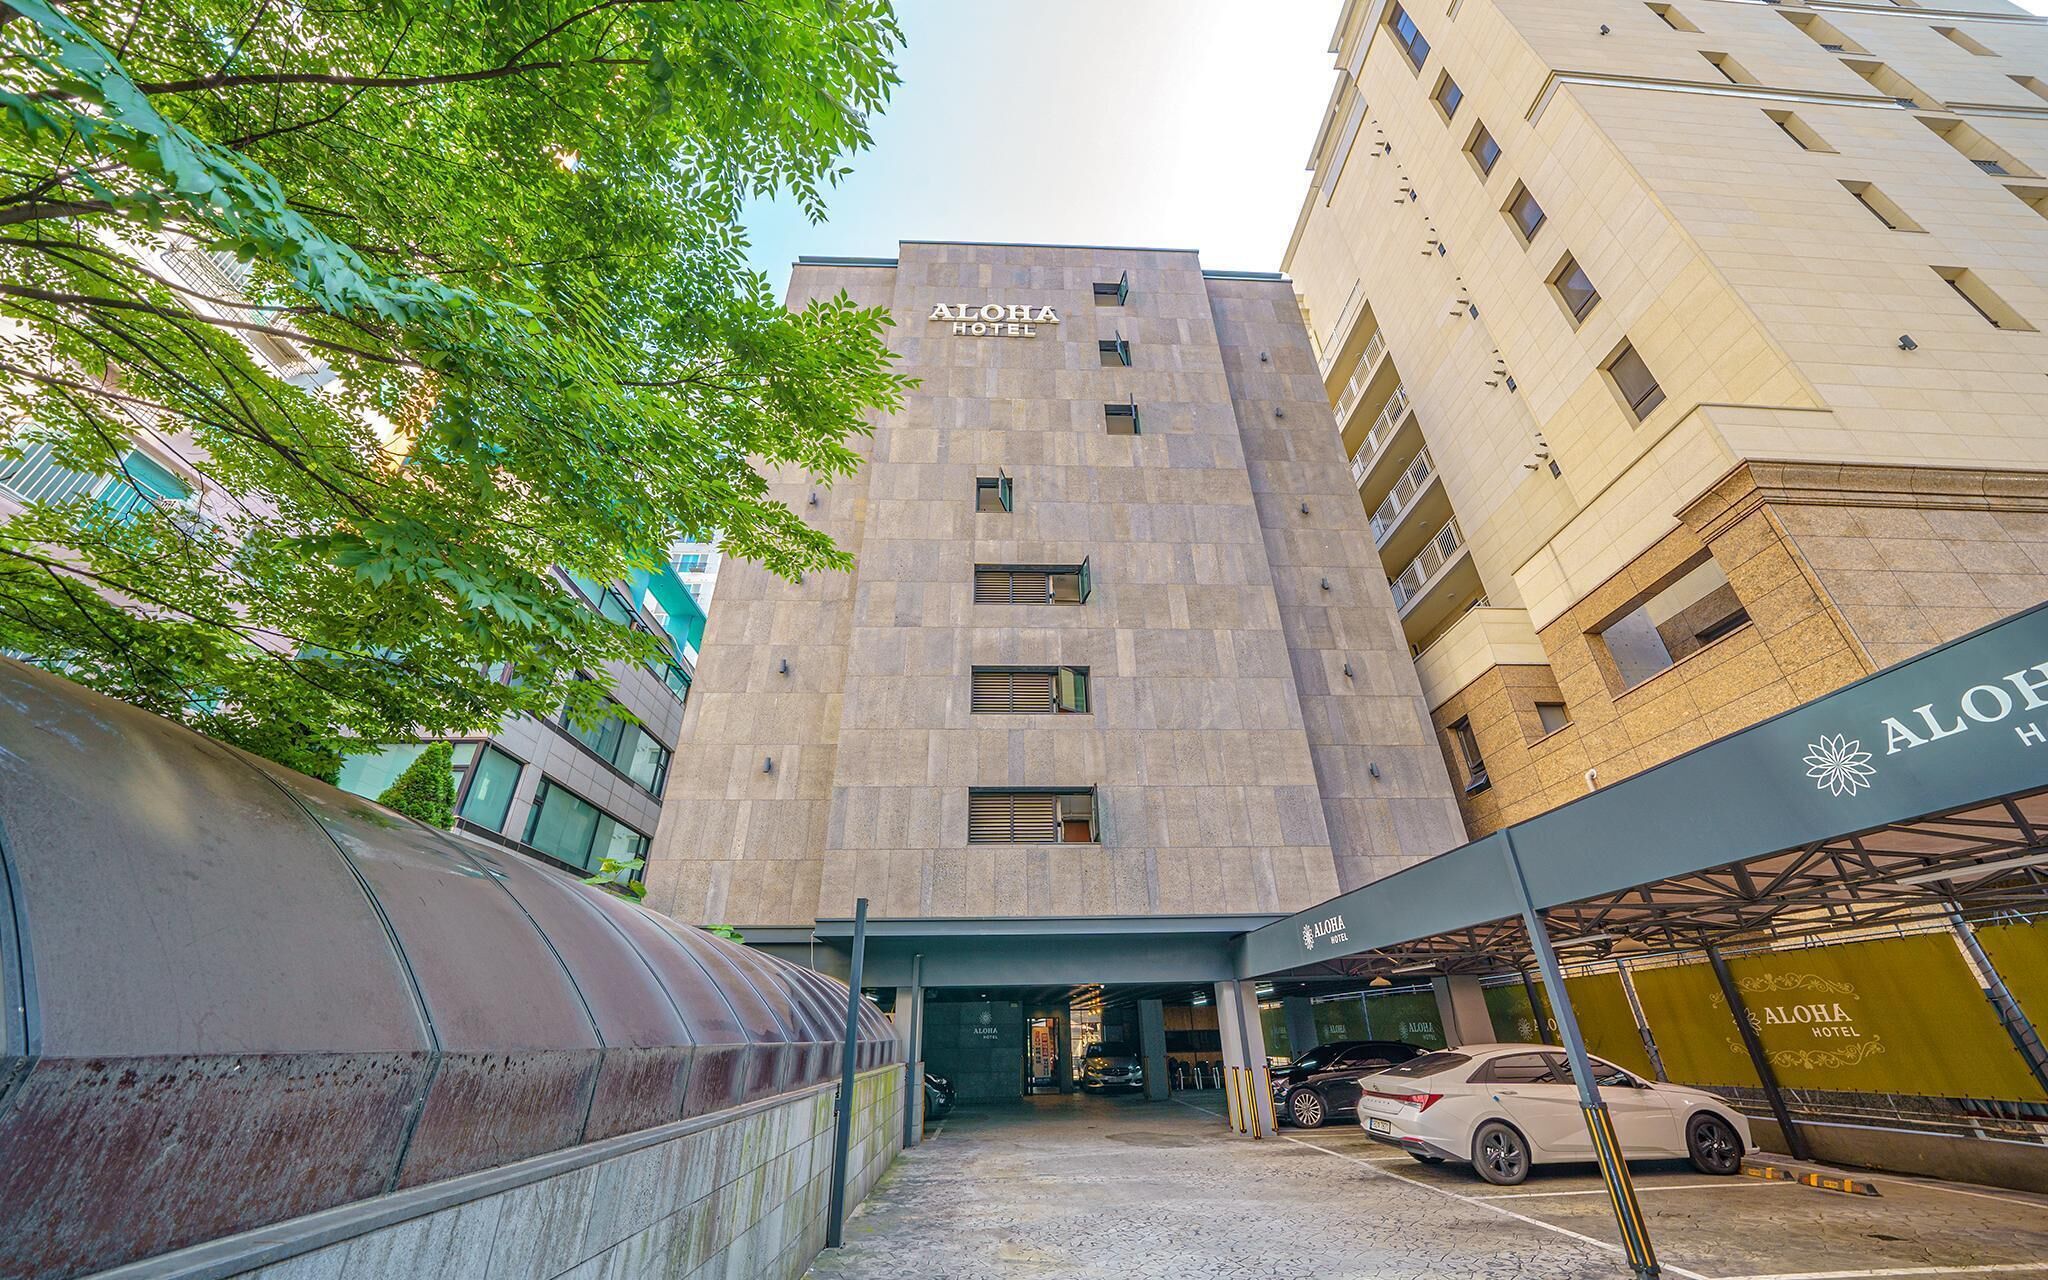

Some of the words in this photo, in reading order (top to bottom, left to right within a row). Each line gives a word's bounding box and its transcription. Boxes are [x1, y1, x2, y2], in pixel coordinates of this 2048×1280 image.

[928, 303, 1060, 324] ALOHA
[952, 322, 1036, 337] HOTEL
[1314, 915, 1345, 938] ALOHA
[1330, 933, 1348, 944] HOTEL
[1764, 1003, 1853, 1024] ALOHA
[1409, 1022, 1435, 1033] ALOHA
[1811, 1026, 1860, 1037] HOTEL
